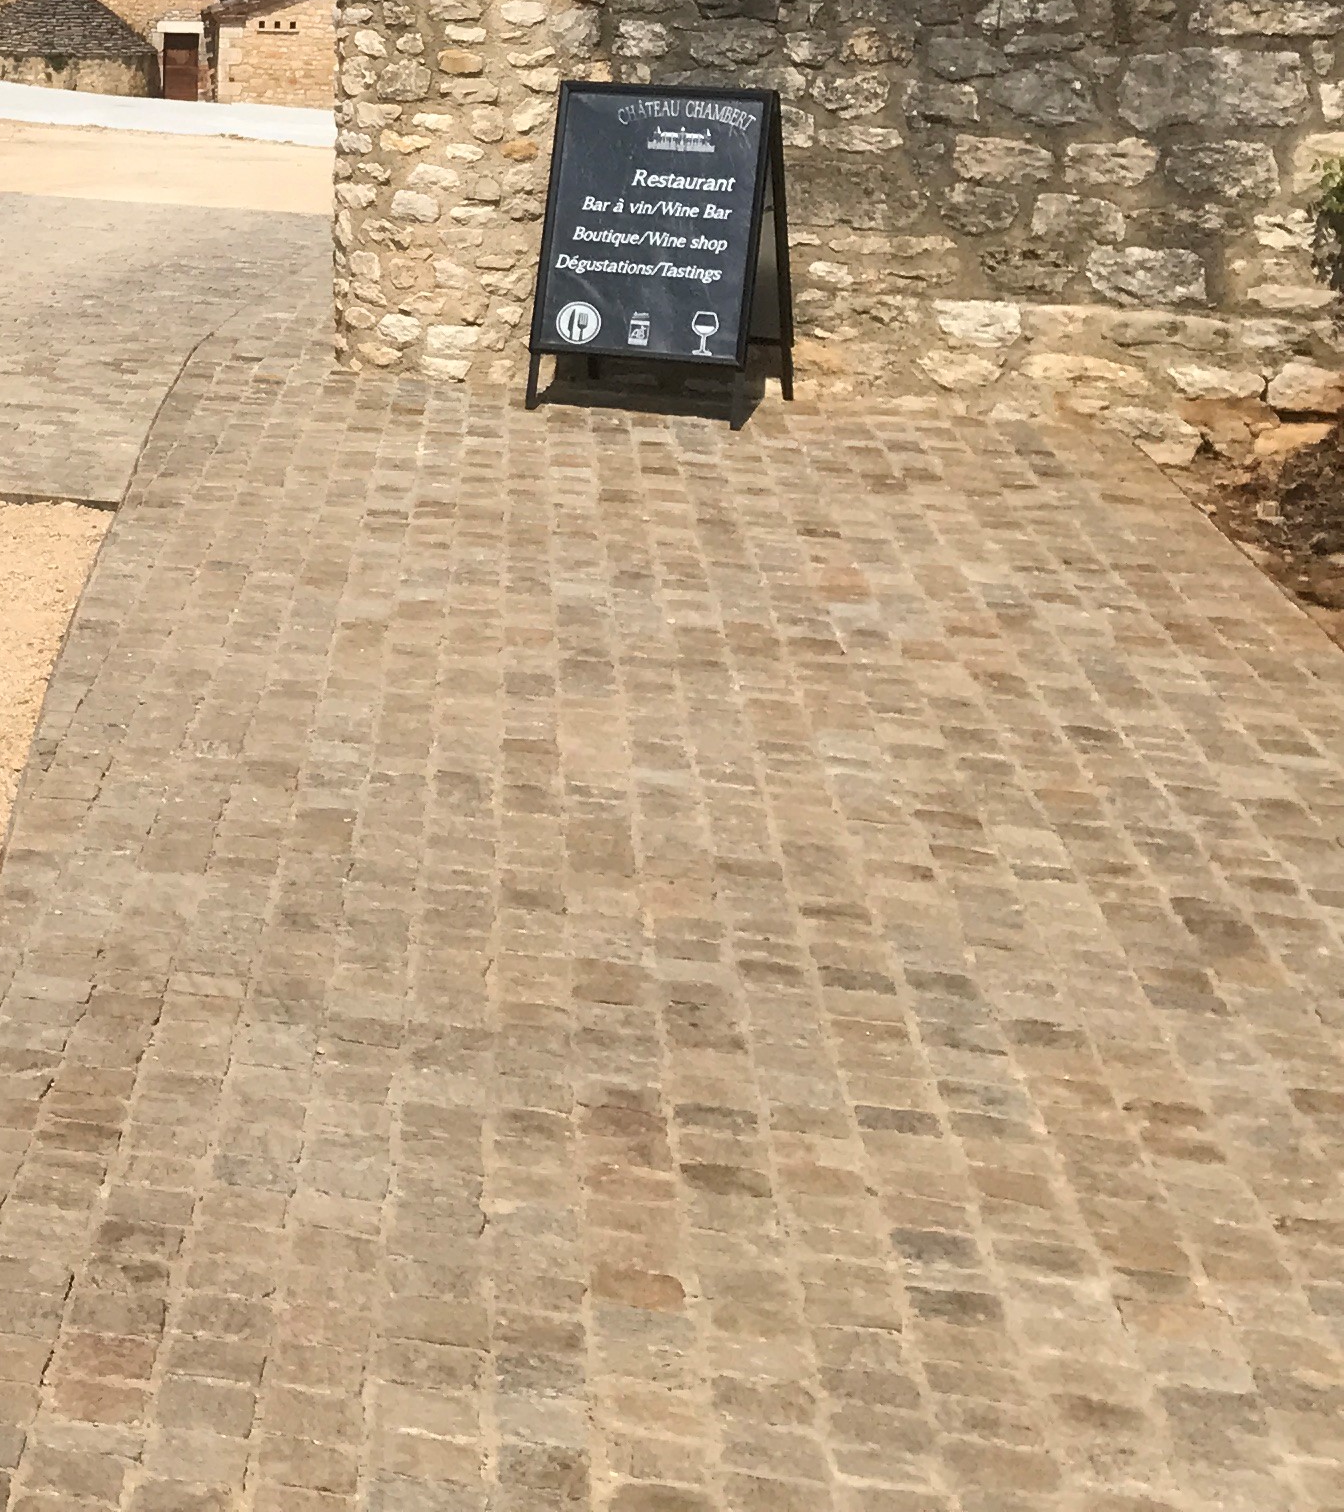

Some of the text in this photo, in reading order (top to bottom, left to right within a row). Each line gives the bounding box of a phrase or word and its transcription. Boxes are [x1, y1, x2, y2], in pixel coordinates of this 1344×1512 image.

[685, 100, 757, 131] CHAMBERT
[631, 168, 736, 192] Restaurant
[581, 195, 733, 220] Bar à vin/Wine Bar
[572, 226, 728, 255] Boutique/Wine shop
[555, 253, 723, 285] Dégustations/Tastings
